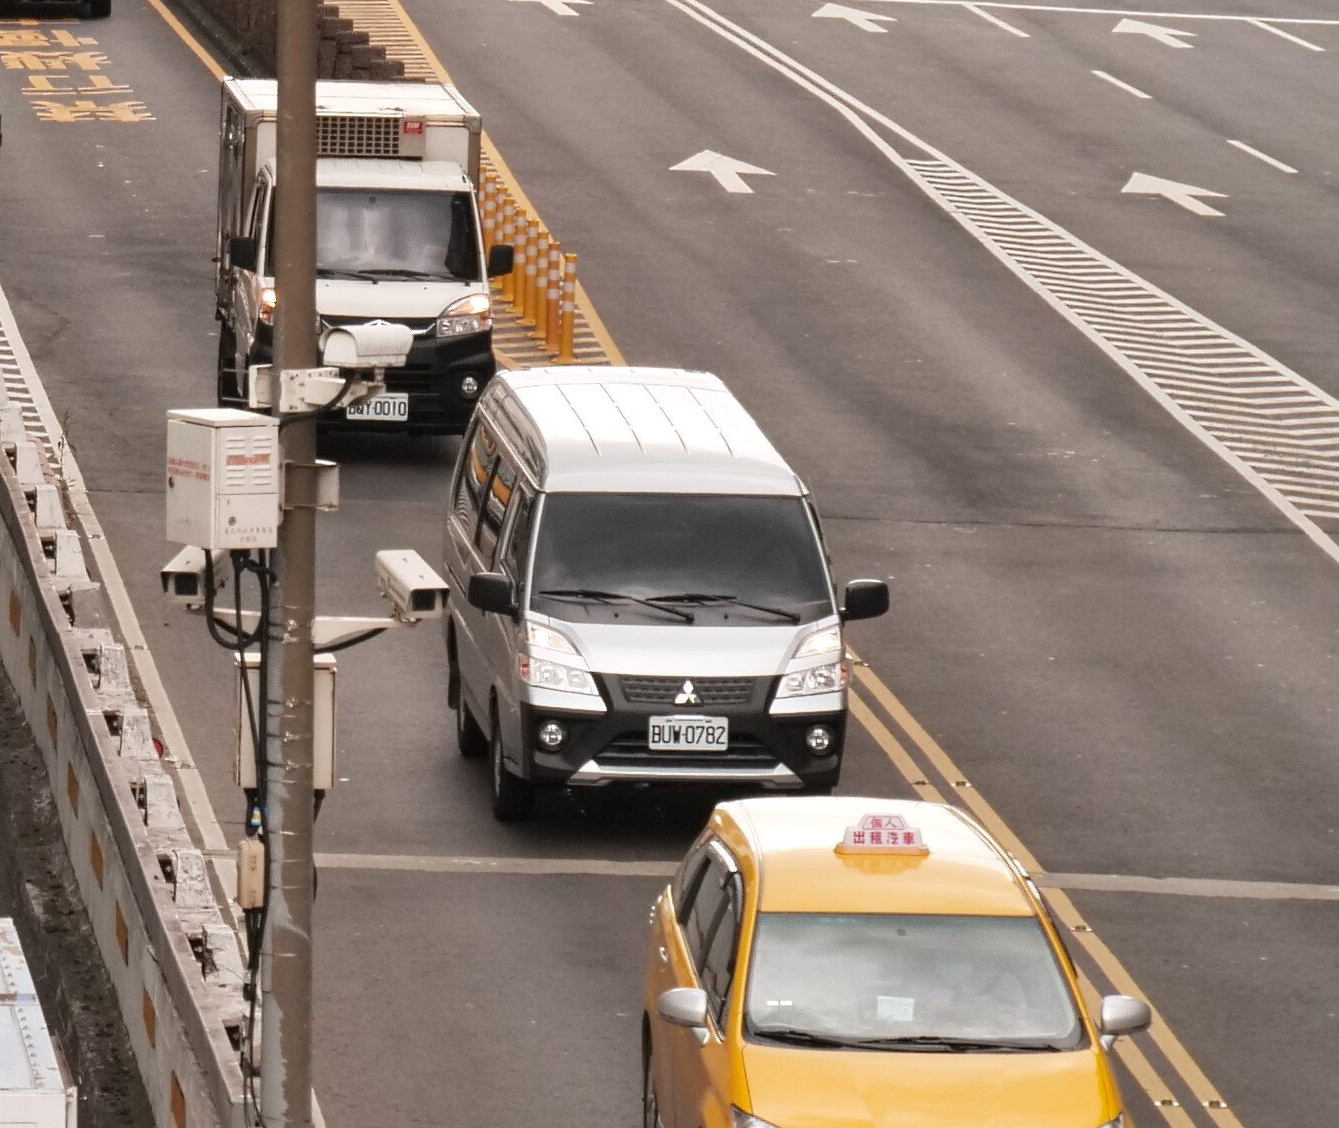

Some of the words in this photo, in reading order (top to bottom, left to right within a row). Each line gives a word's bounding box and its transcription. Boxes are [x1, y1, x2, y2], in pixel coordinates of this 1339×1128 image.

[651, 724, 726, 746] BUW-0782
[869, 816, 899, 830] 個人
[851, 830, 917, 846] 出租汽車
